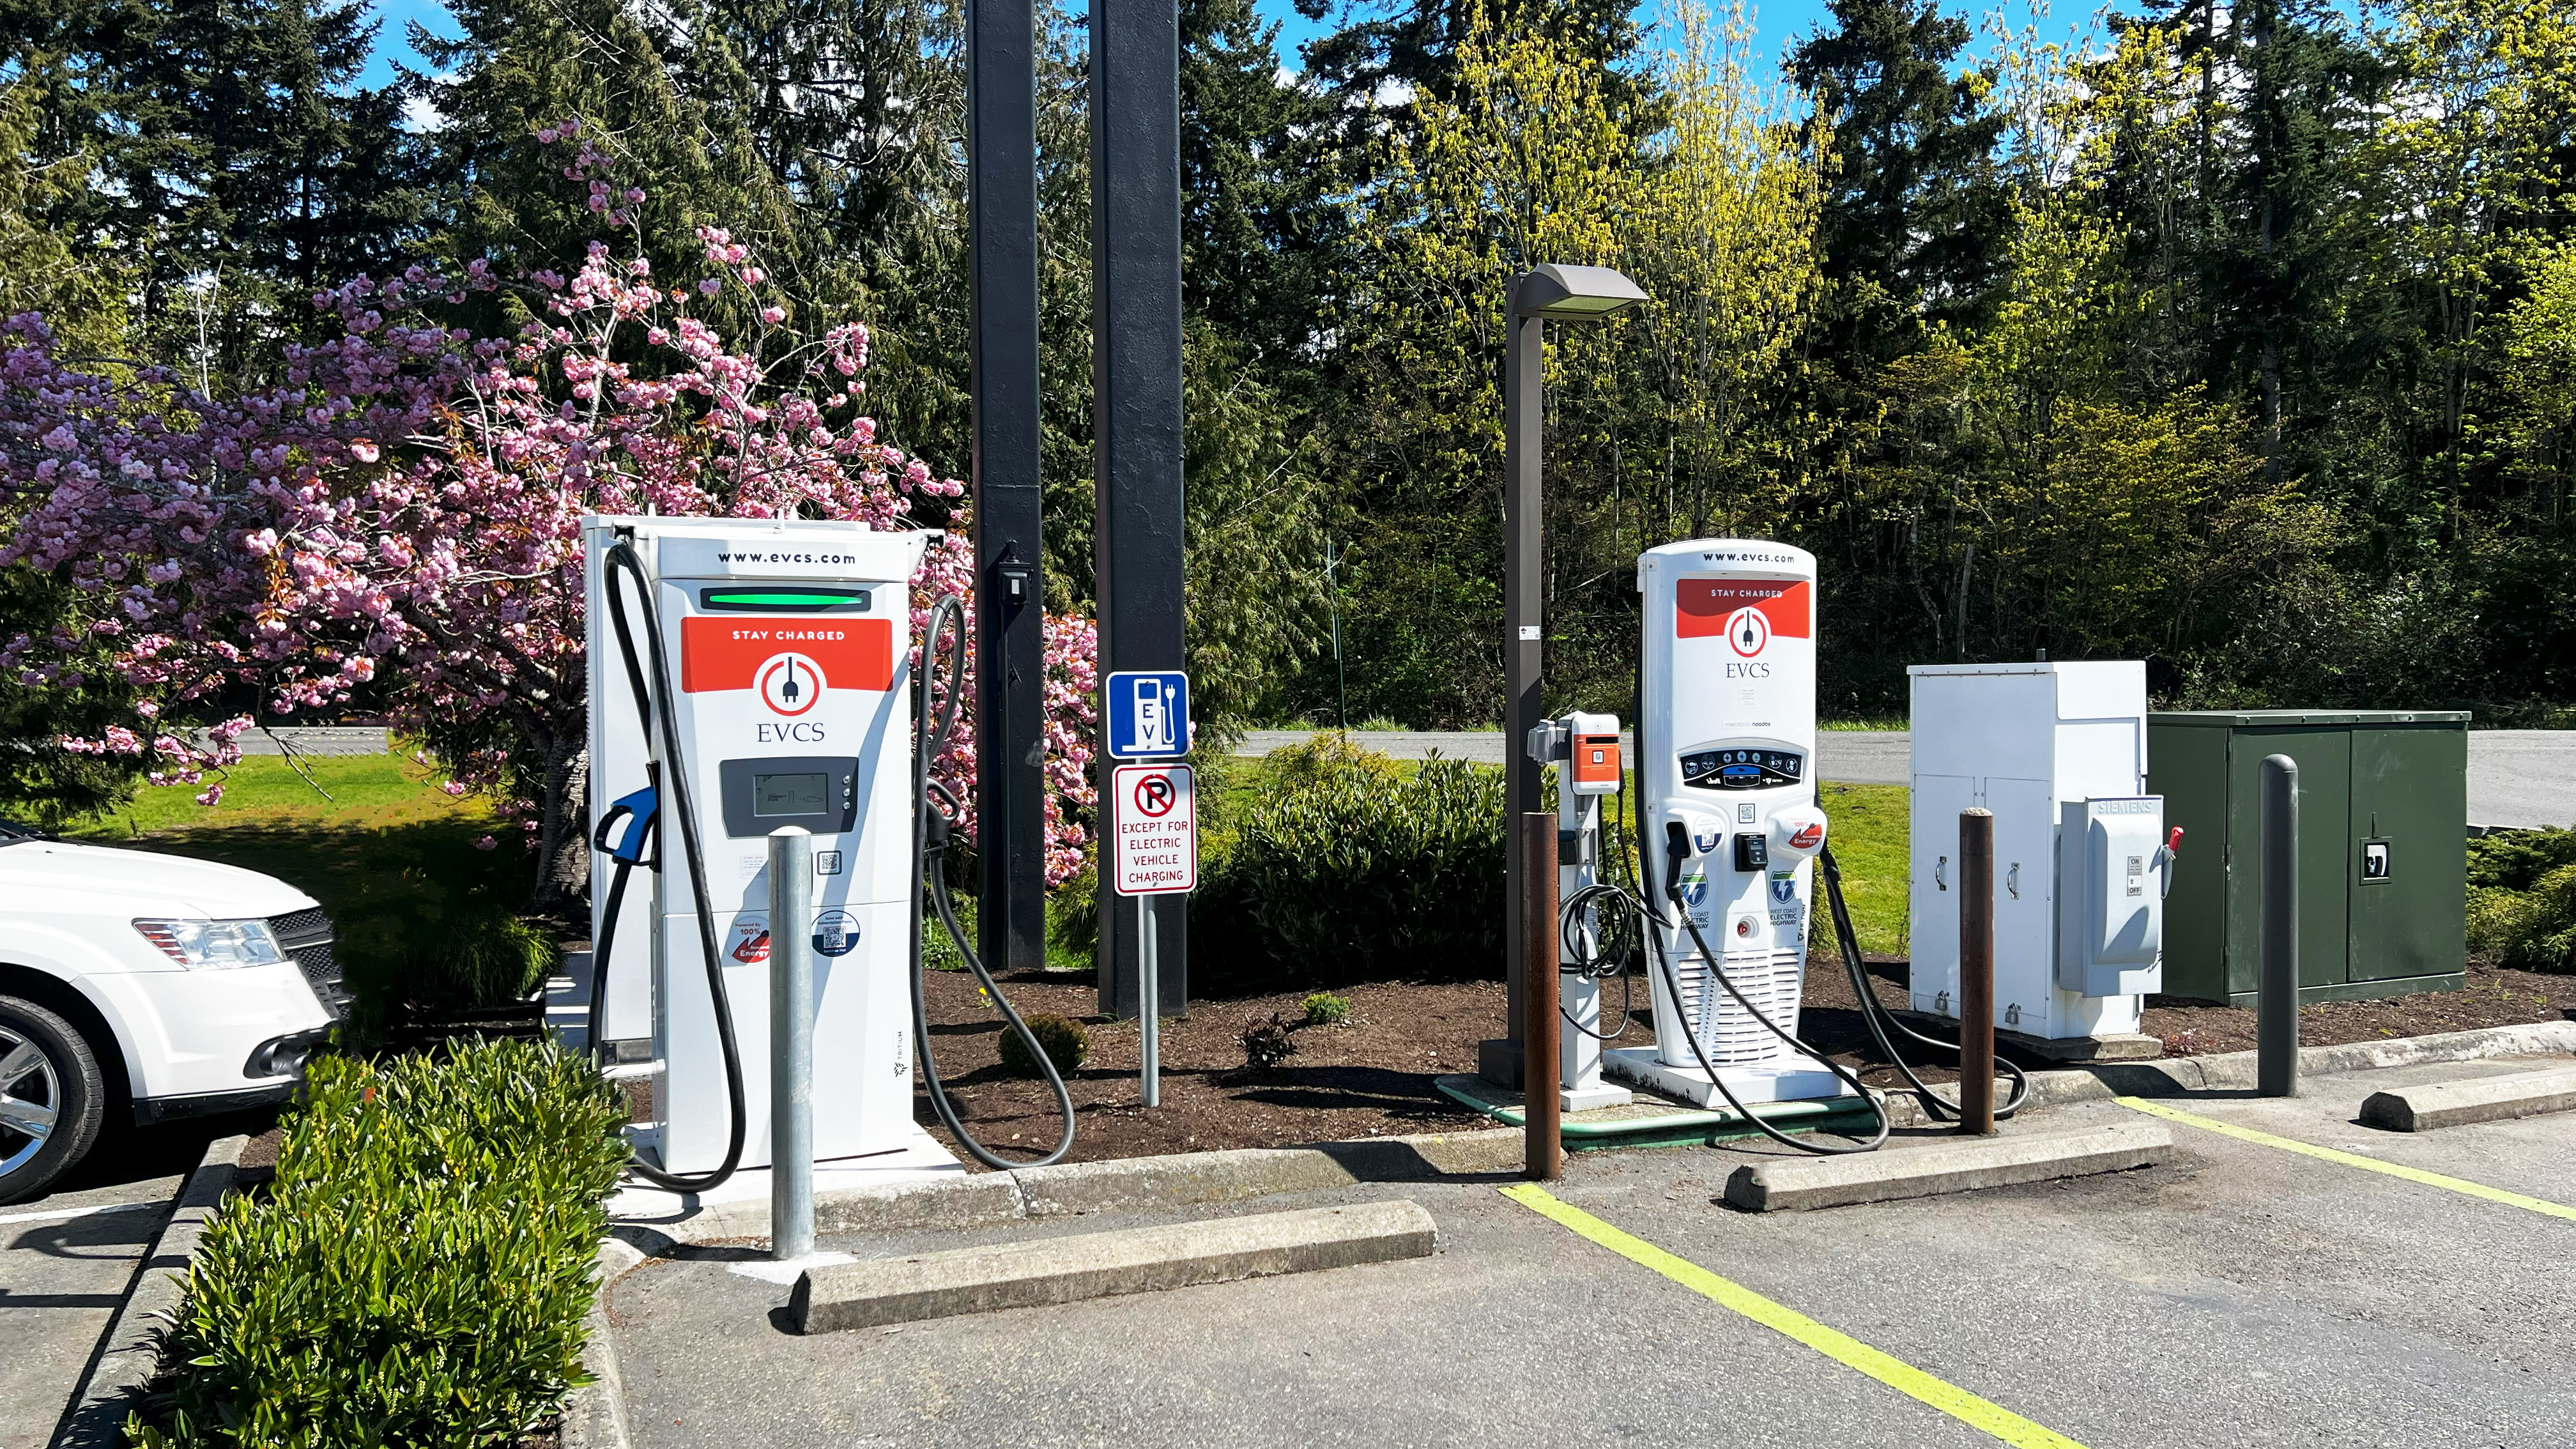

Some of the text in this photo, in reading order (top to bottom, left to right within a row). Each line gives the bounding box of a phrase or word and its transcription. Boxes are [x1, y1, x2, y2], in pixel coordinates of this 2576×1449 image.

[718, 552, 855, 564] www.evcs.com
[1703, 553, 1795, 563] www.evcs.com
[1739, 590, 1782, 598] CHARGED
[732, 630, 845, 641] STAY CHARGED
[1726, 663, 1770, 678] EVCS
[757, 723, 825, 743] EVCS
[2099, 801, 2152, 814] SIEMENS
[1122, 821, 1188, 834] EXCEPT FOR
[1130, 838, 1181, 850] ELECTRIC
[1133, 854, 1178, 866] VEHICLE
[1129, 871, 1183, 883] CHARGING
[740, 949, 769, 958] Energy
